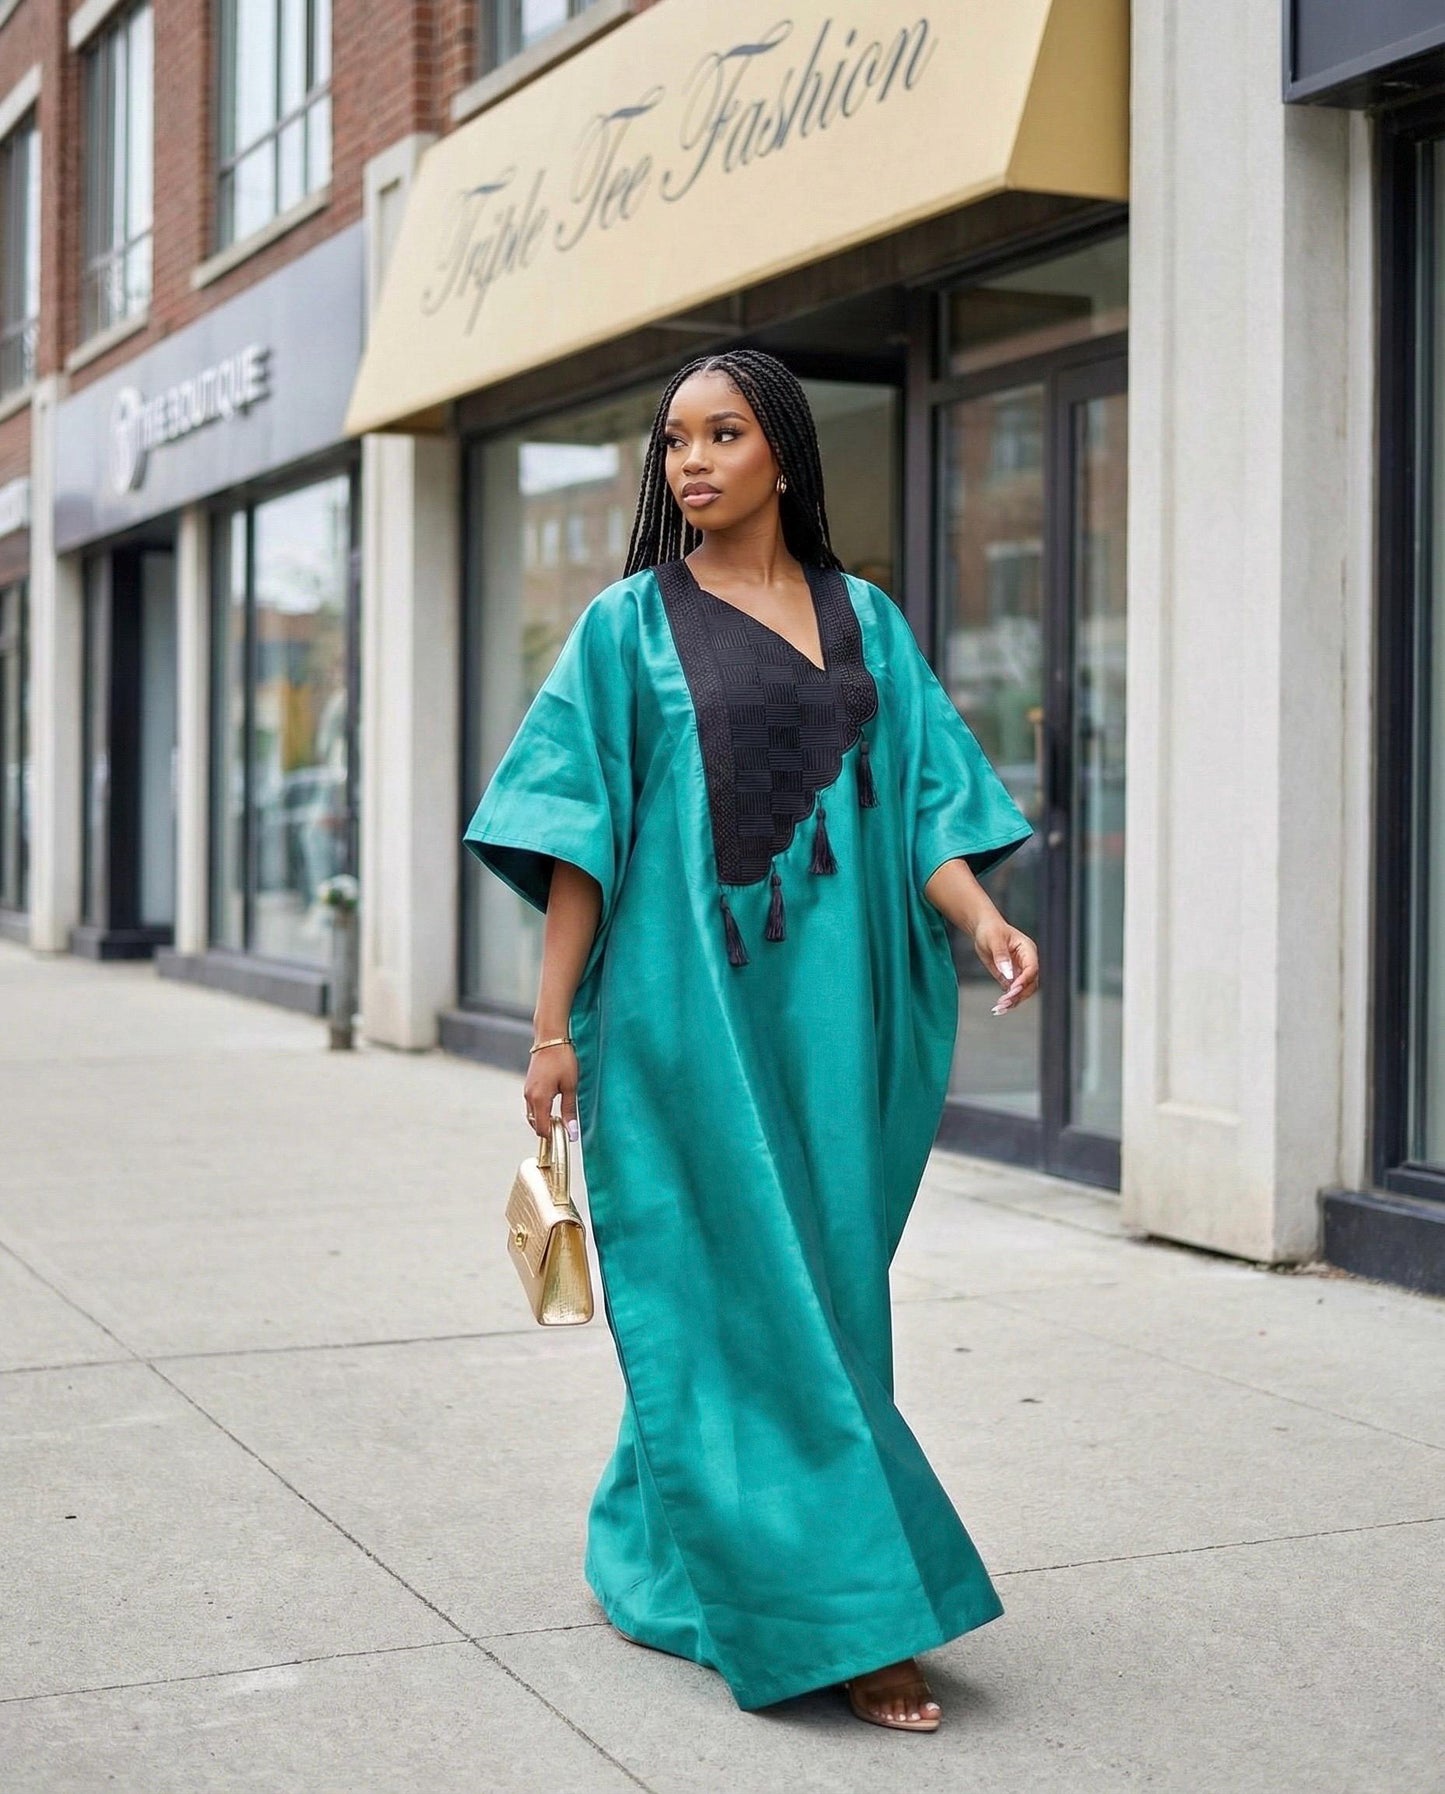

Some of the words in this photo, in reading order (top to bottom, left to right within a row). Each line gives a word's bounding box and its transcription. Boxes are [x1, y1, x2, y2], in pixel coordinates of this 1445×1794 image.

[420, 165, 547, 334] Triple
[554, 85, 664, 252] Tee
[660, 18, 938, 202] Fashion
